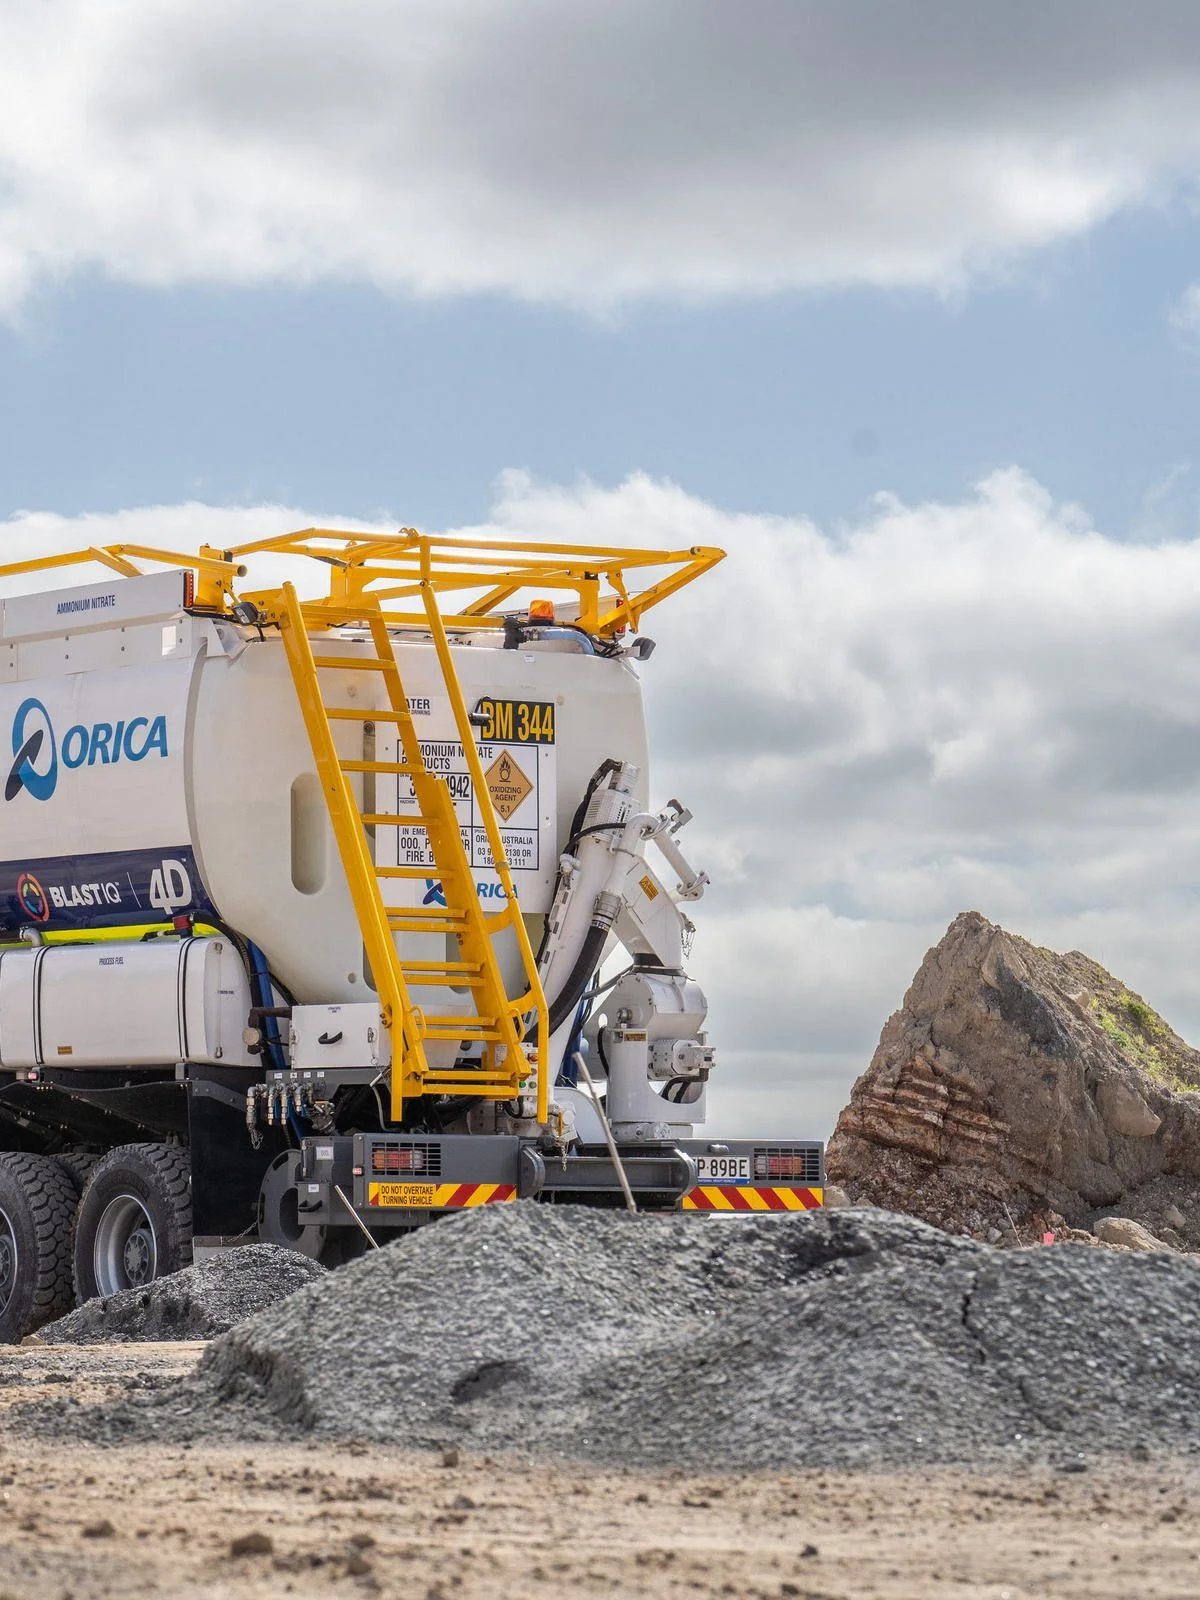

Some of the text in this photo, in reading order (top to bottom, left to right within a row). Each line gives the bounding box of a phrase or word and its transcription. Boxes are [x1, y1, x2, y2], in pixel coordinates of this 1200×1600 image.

[56, 595, 116, 615] AMMONIUM NITRATE
[406, 698, 430, 709] TER
[482, 701, 554, 742] BM 344
[61, 715, 169, 769] ORICA
[489, 786, 522, 794] OXIDIZING
[495, 794, 517, 802] AGENT
[500, 804, 510, 813] 5.1
[502, 836, 533, 845] USTRALIA
[477, 847, 486, 855] 03
[522, 849, 532, 857] OR
[406, 850, 424, 862] FIRE
[514, 858, 526, 866] 111
[99, 956, 124, 965] PROCESS FUEL
[381, 1185, 434, 1195] DO NOT OVERTAKE
[382, 1196, 433, 1205] TURNING VEHICLE
